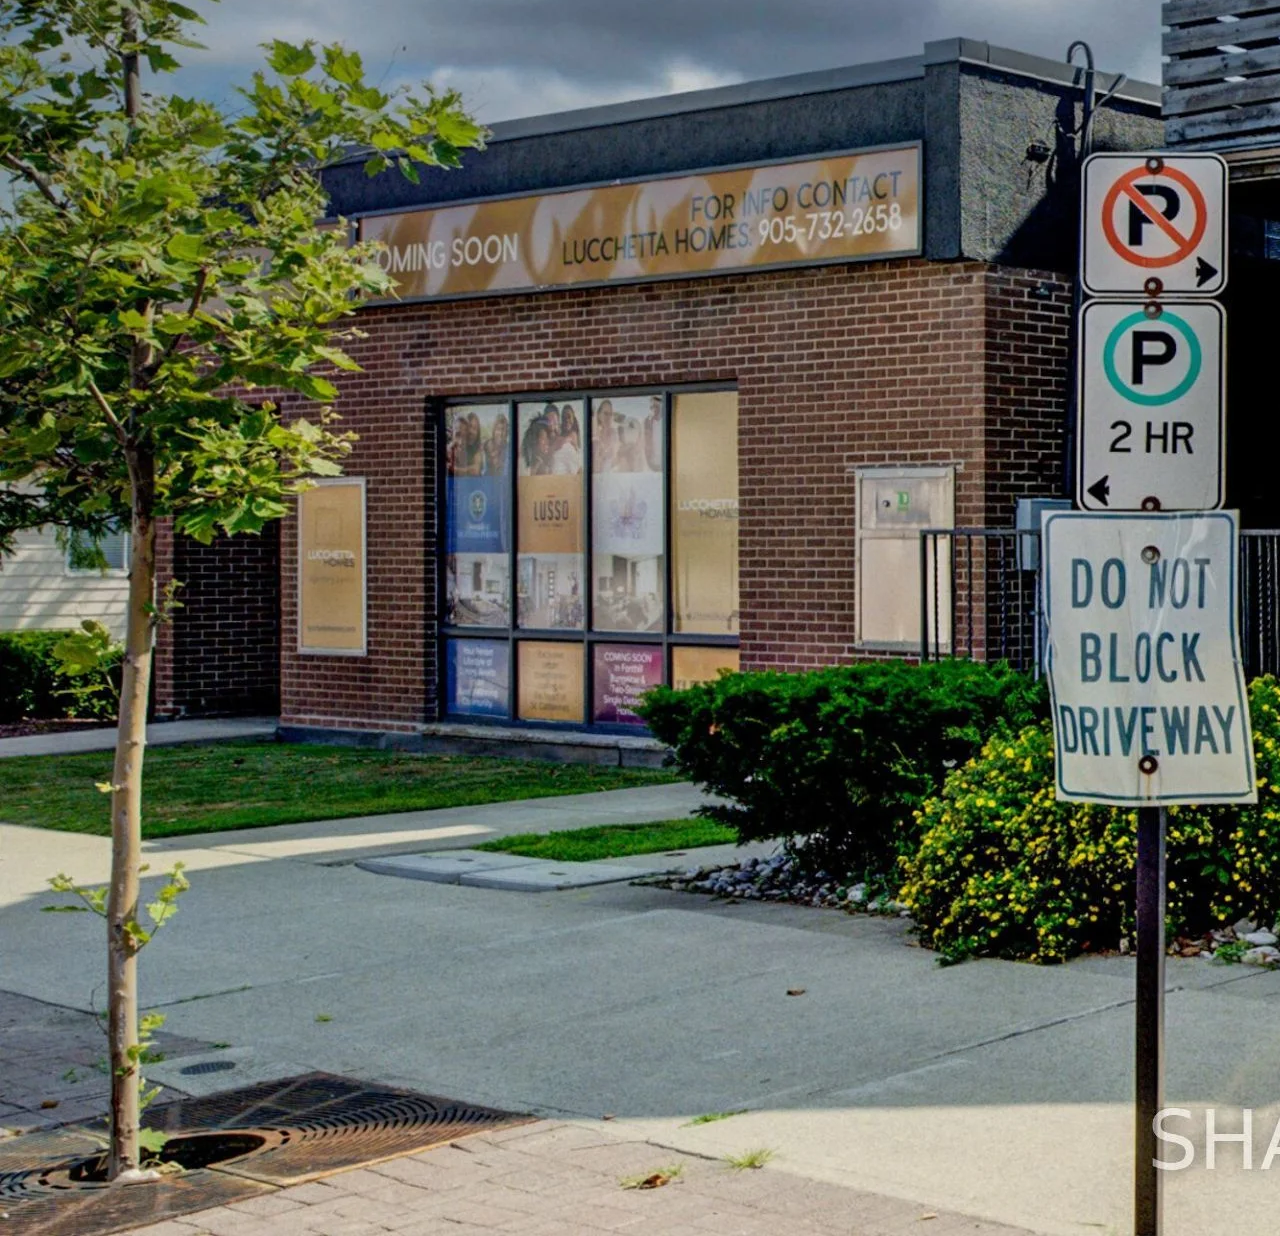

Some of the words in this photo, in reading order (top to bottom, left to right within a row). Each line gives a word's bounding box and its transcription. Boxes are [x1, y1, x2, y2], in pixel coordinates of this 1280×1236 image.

[691, 192, 735, 221] FOR
[743, 185, 788, 215] INFO
[796, 171, 902, 210] CONTACT
[375, 241, 446, 274] OMING
[451, 233, 519, 266] SOON
[562, 232, 669, 265] LUCCHETTA
[675, 221, 752, 253] HOMES:
[759, 202, 902, 246] 905-732-2658
[1131, 330, 1177, 385] P
[1109, 420, 1132, 453] 2
[1145, 421, 1195, 454] HR
[533, 500, 569, 521] LUSSO
[1071, 557, 1127, 610] DO
[1149, 558, 1211, 610] NOT
[632, 652, 653, 663] SOON
[1080, 631, 1206, 684] BLOCK
[1059, 704, 1238, 759] DRIVEWAY
